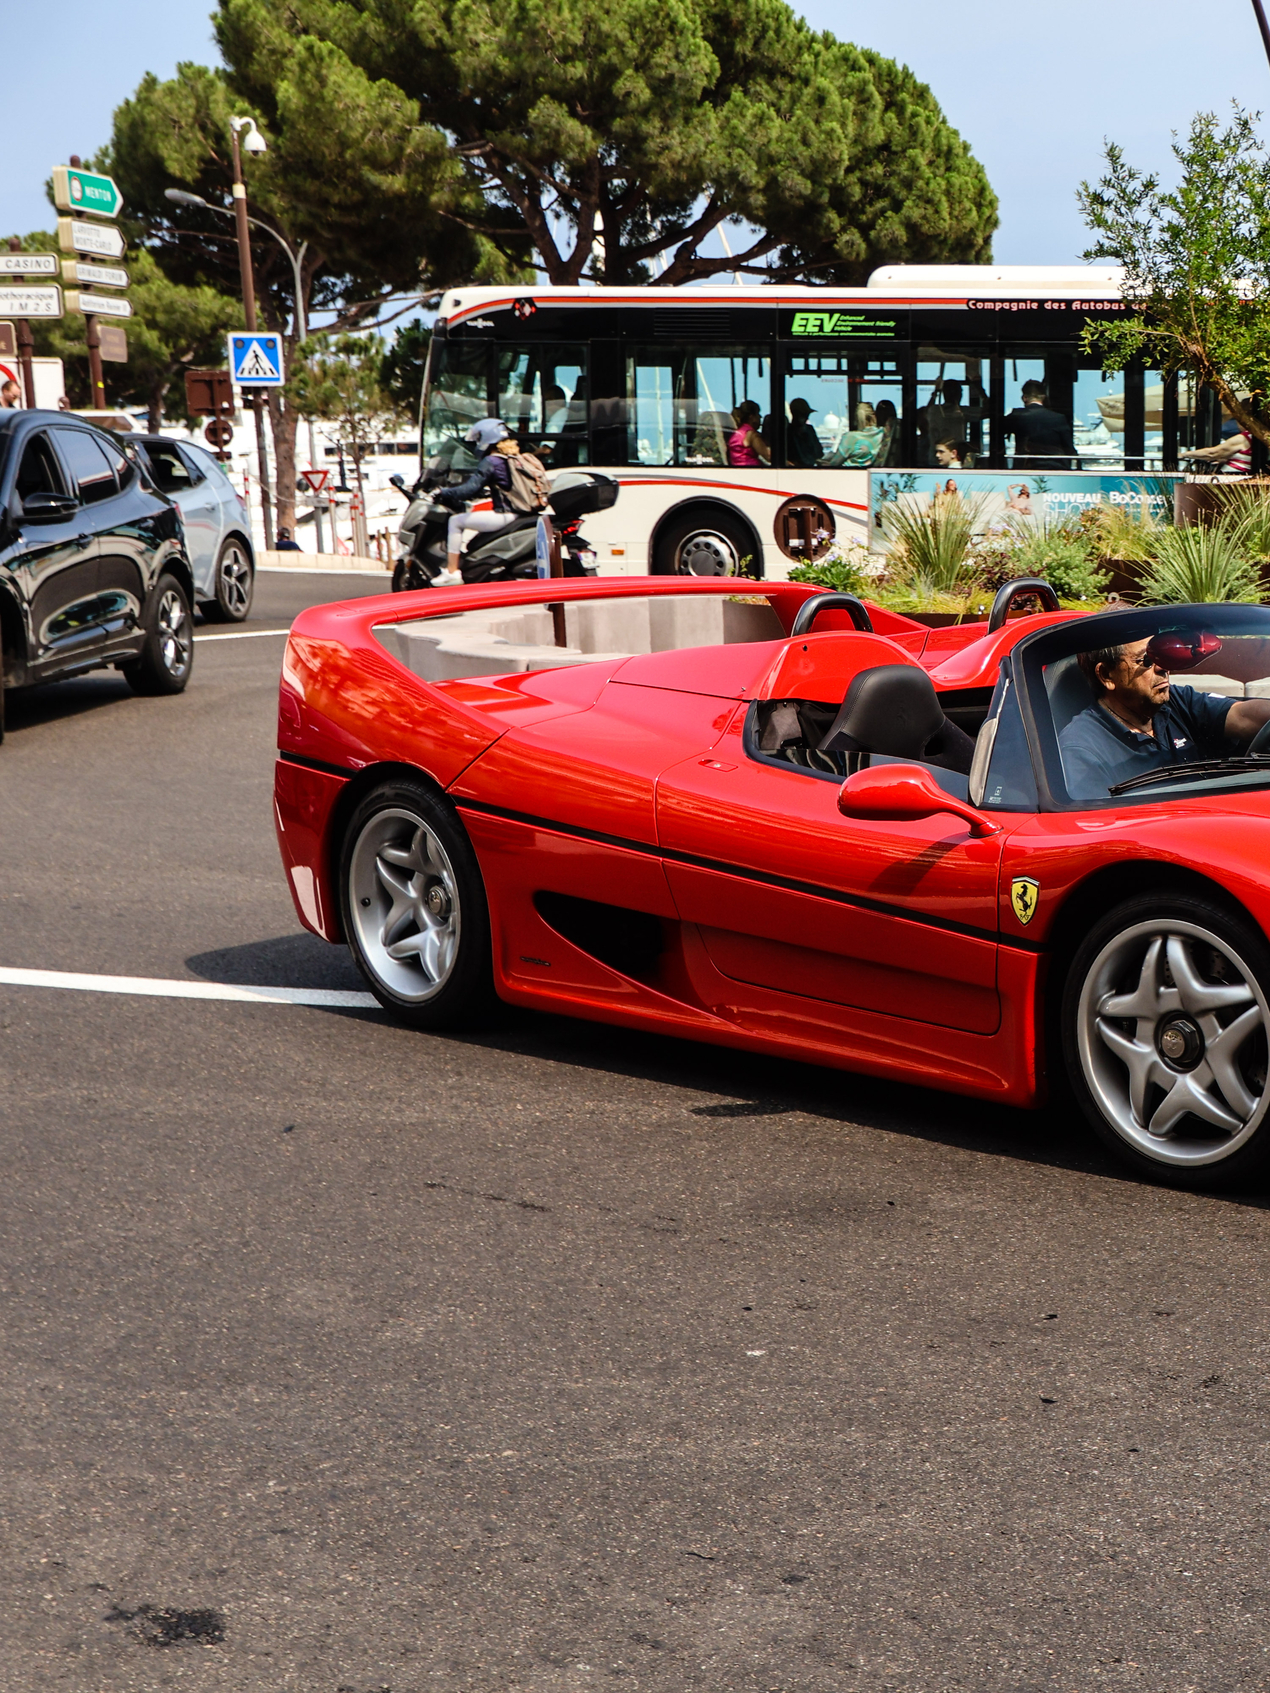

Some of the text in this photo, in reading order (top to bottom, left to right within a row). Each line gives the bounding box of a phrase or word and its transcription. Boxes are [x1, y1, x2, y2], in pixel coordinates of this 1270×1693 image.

[84, 186, 112, 202] MENTON
[75, 236, 112, 252] MONTE-CARLO
[5, 259, 51, 269] CASINO
[968, 300, 1039, 311] Compagnie
[1044, 300, 1066, 310] des
[1071, 301, 1126, 310] Autobus
[791, 312, 841, 333] EEV
[1043, 492, 1101, 503] NOUVEAU
[1109, 491, 1175, 507] BoConce
